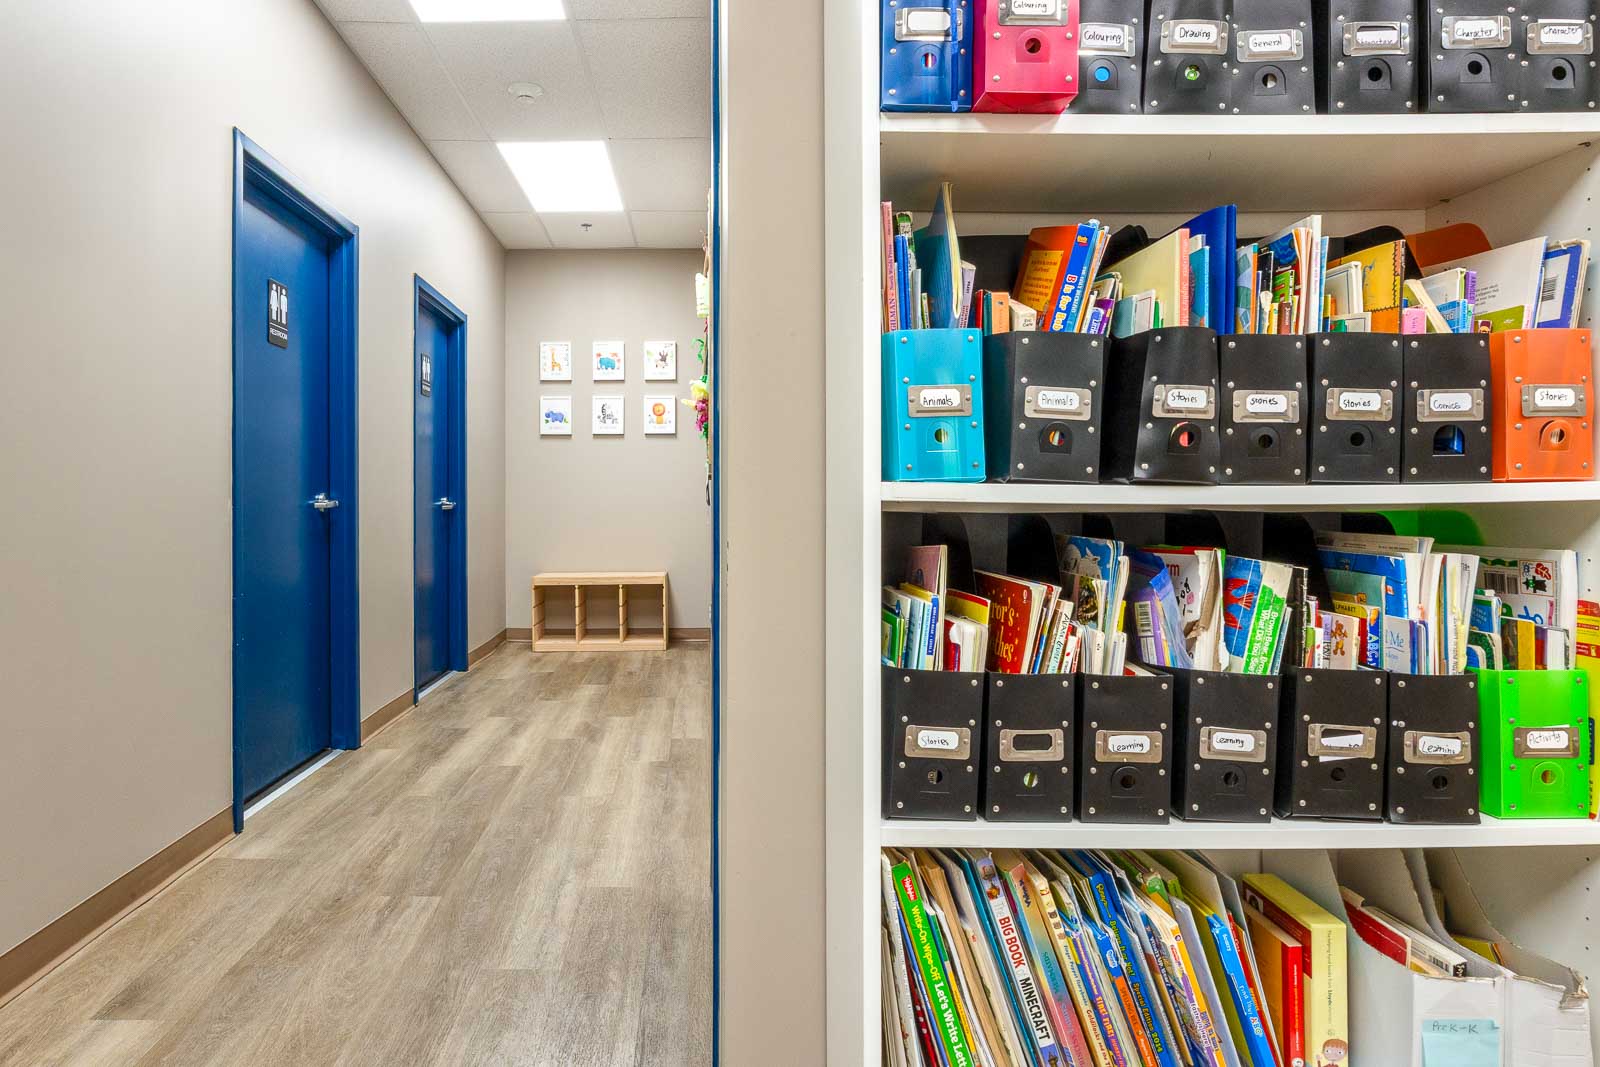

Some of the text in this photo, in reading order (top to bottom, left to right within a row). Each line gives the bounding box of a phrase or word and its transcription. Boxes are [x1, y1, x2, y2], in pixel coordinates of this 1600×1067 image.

[1013, 0, 1047, 13] Colouring
[1084, 30, 1121, 43] Colouring
[1180, 27, 1211, 40] Drawing
[1456, 26, 1494, 38] Character
[1253, 35, 1282, 48] General
[923, 397, 953, 407] Animals
[1041, 393, 1074, 406] Animals
[1171, 389, 1198, 403] Stories
[1250, 396, 1279, 406] Stories
[1540, 390, 1568, 401] Stories
[1343, 397, 1371, 408] Stories
[921, 735, 949, 746] Stories
[1216, 736, 1244, 748] Learning
[1528, 732, 1561, 744] Activity
[1112, 739, 1144, 752] Learning
[999, 916, 1013, 934] BIG
[1005, 936, 1024, 968] BOOK
[910, 905, 967, 1067] Write-On Wipe-Off Let's Write Lett
[1019, 977, 1049, 1041] MINECRAFT
[1132, 982, 1145, 1006] Special
[1151, 1032, 1162, 1052] 2014
